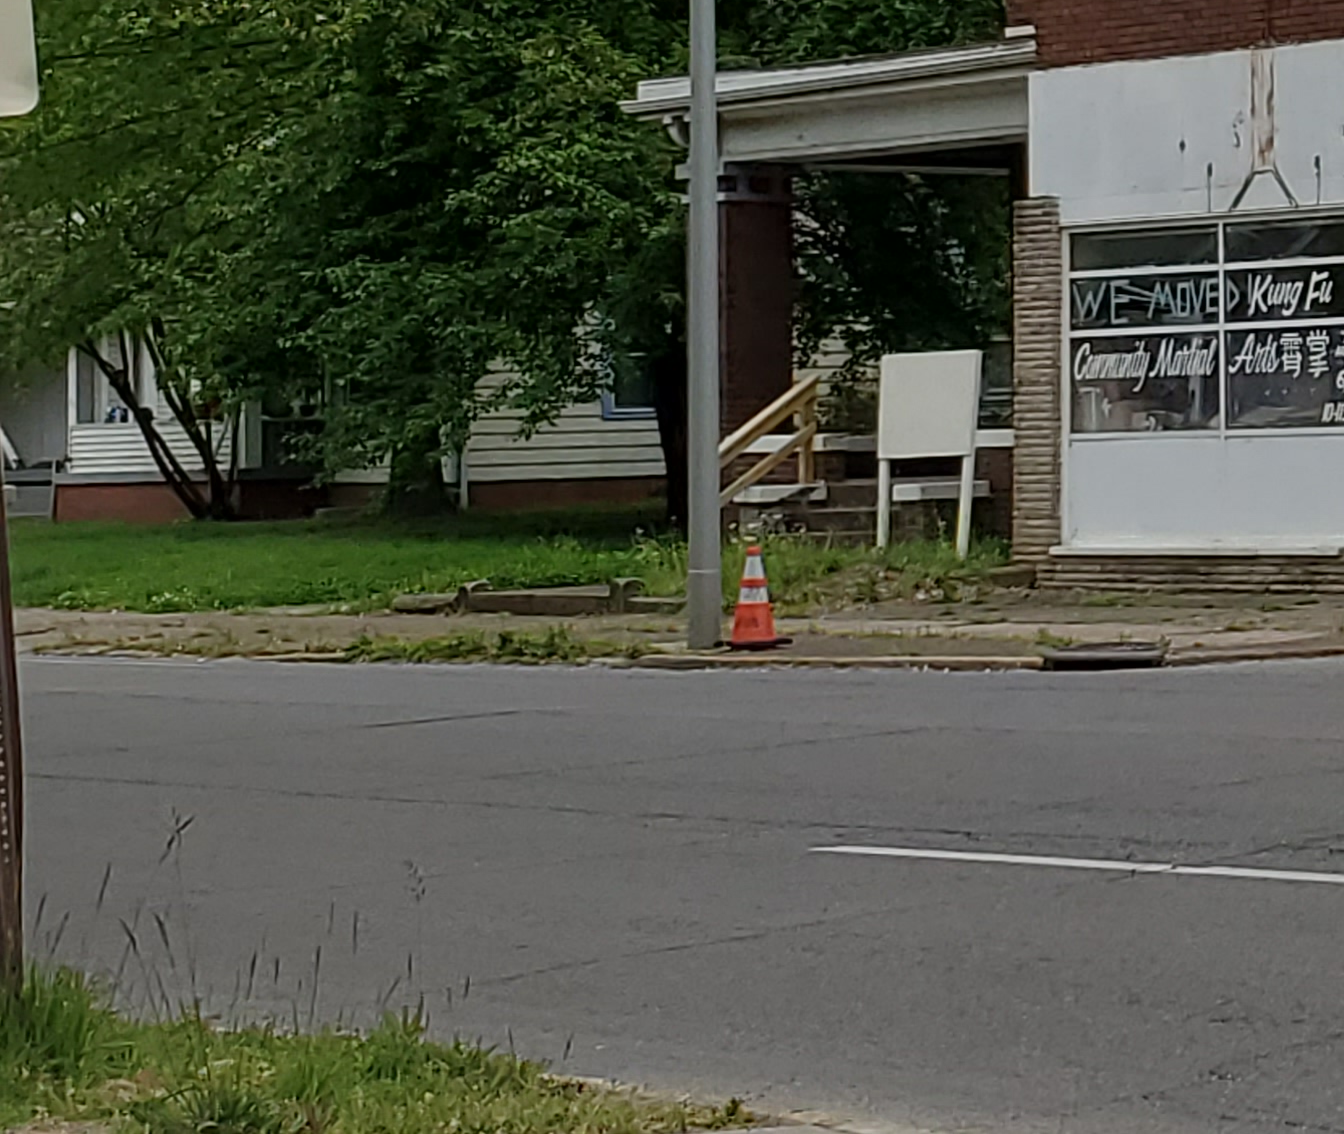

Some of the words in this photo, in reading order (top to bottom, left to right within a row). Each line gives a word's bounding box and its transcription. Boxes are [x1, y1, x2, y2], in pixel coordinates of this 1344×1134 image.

[1072, 279, 1130, 325] WE
[1248, 273, 1304, 317] Kung
[1304, 270, 1333, 311] Fu
[1073, 340, 1151, 392] Community
[1149, 337, 1218, 377] Martial
[1228, 332, 1280, 374] Arts
